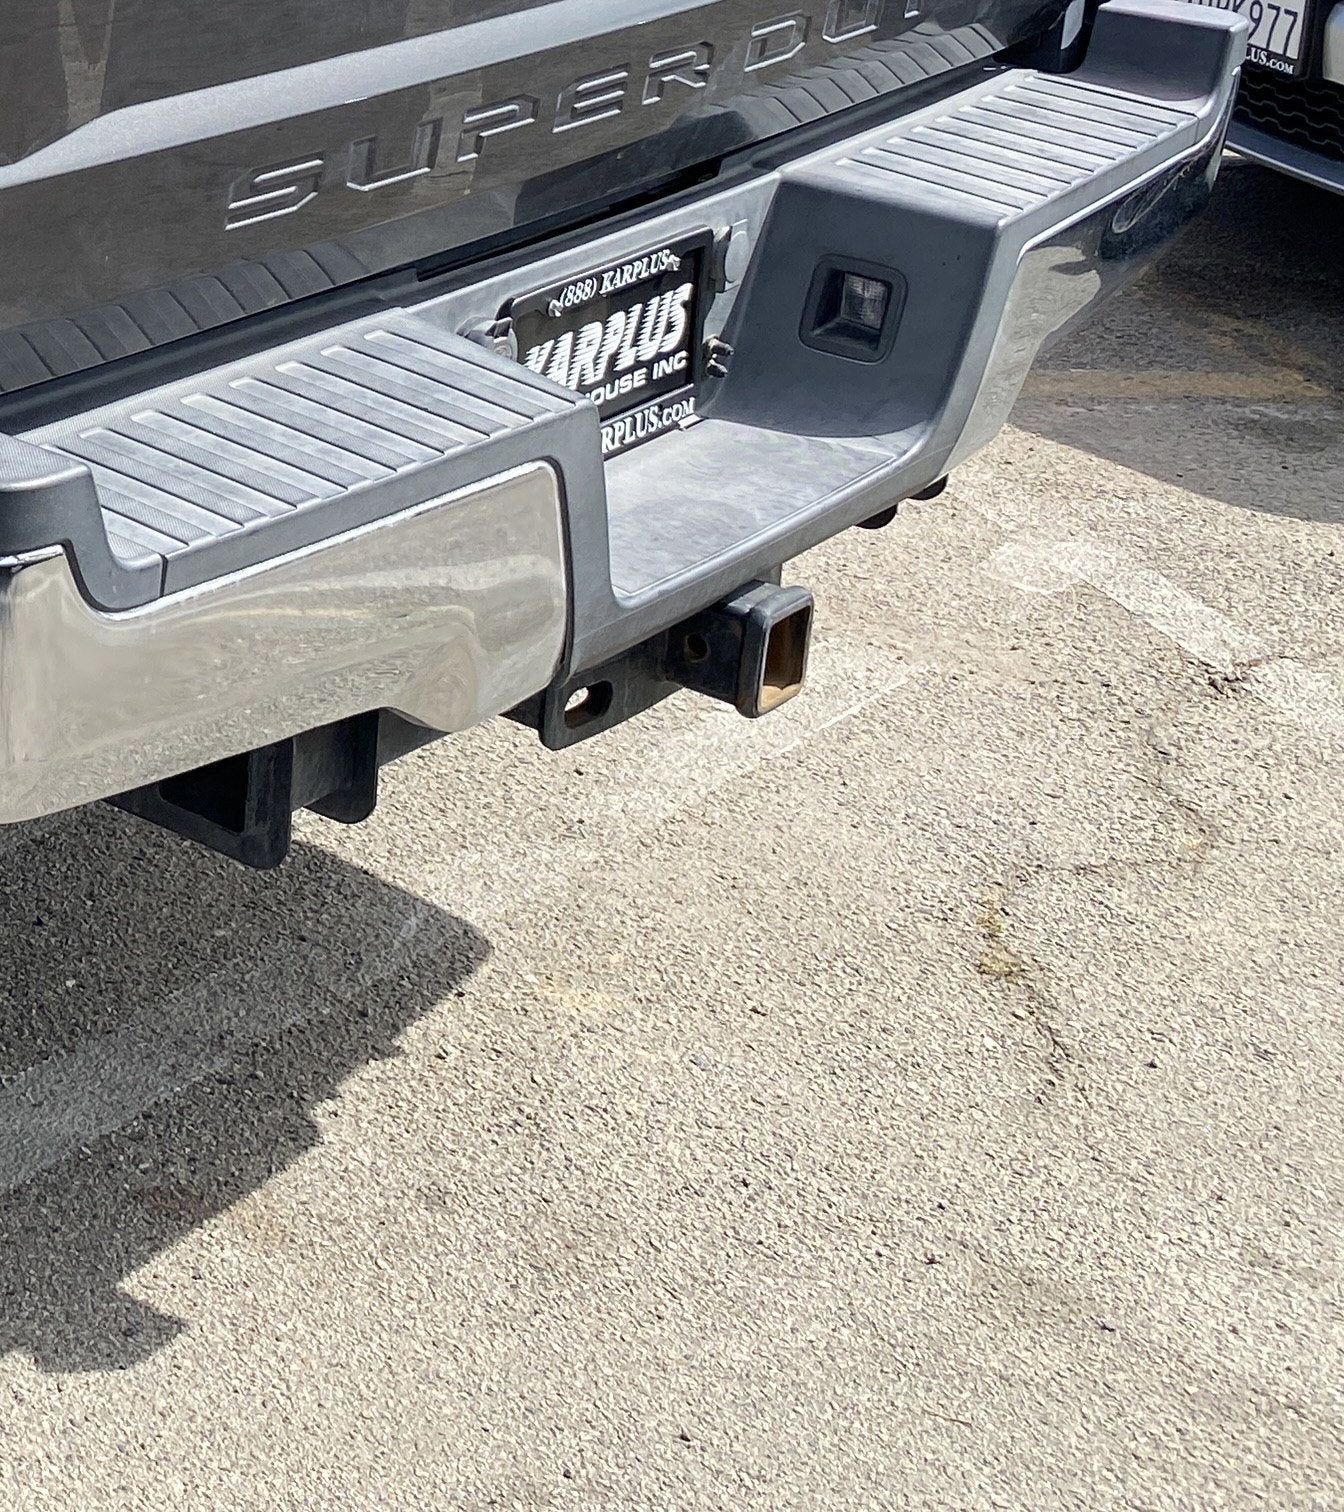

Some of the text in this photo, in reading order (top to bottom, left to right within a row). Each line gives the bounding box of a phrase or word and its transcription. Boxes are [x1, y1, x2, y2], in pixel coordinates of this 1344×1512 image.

[224, 40, 714, 230] SUPER
[560, 249, 671, 308] (888) KARPLUS
[585, 350, 689, 405] OUSE INC
[601, 397, 695, 454] RPLUS.COM
